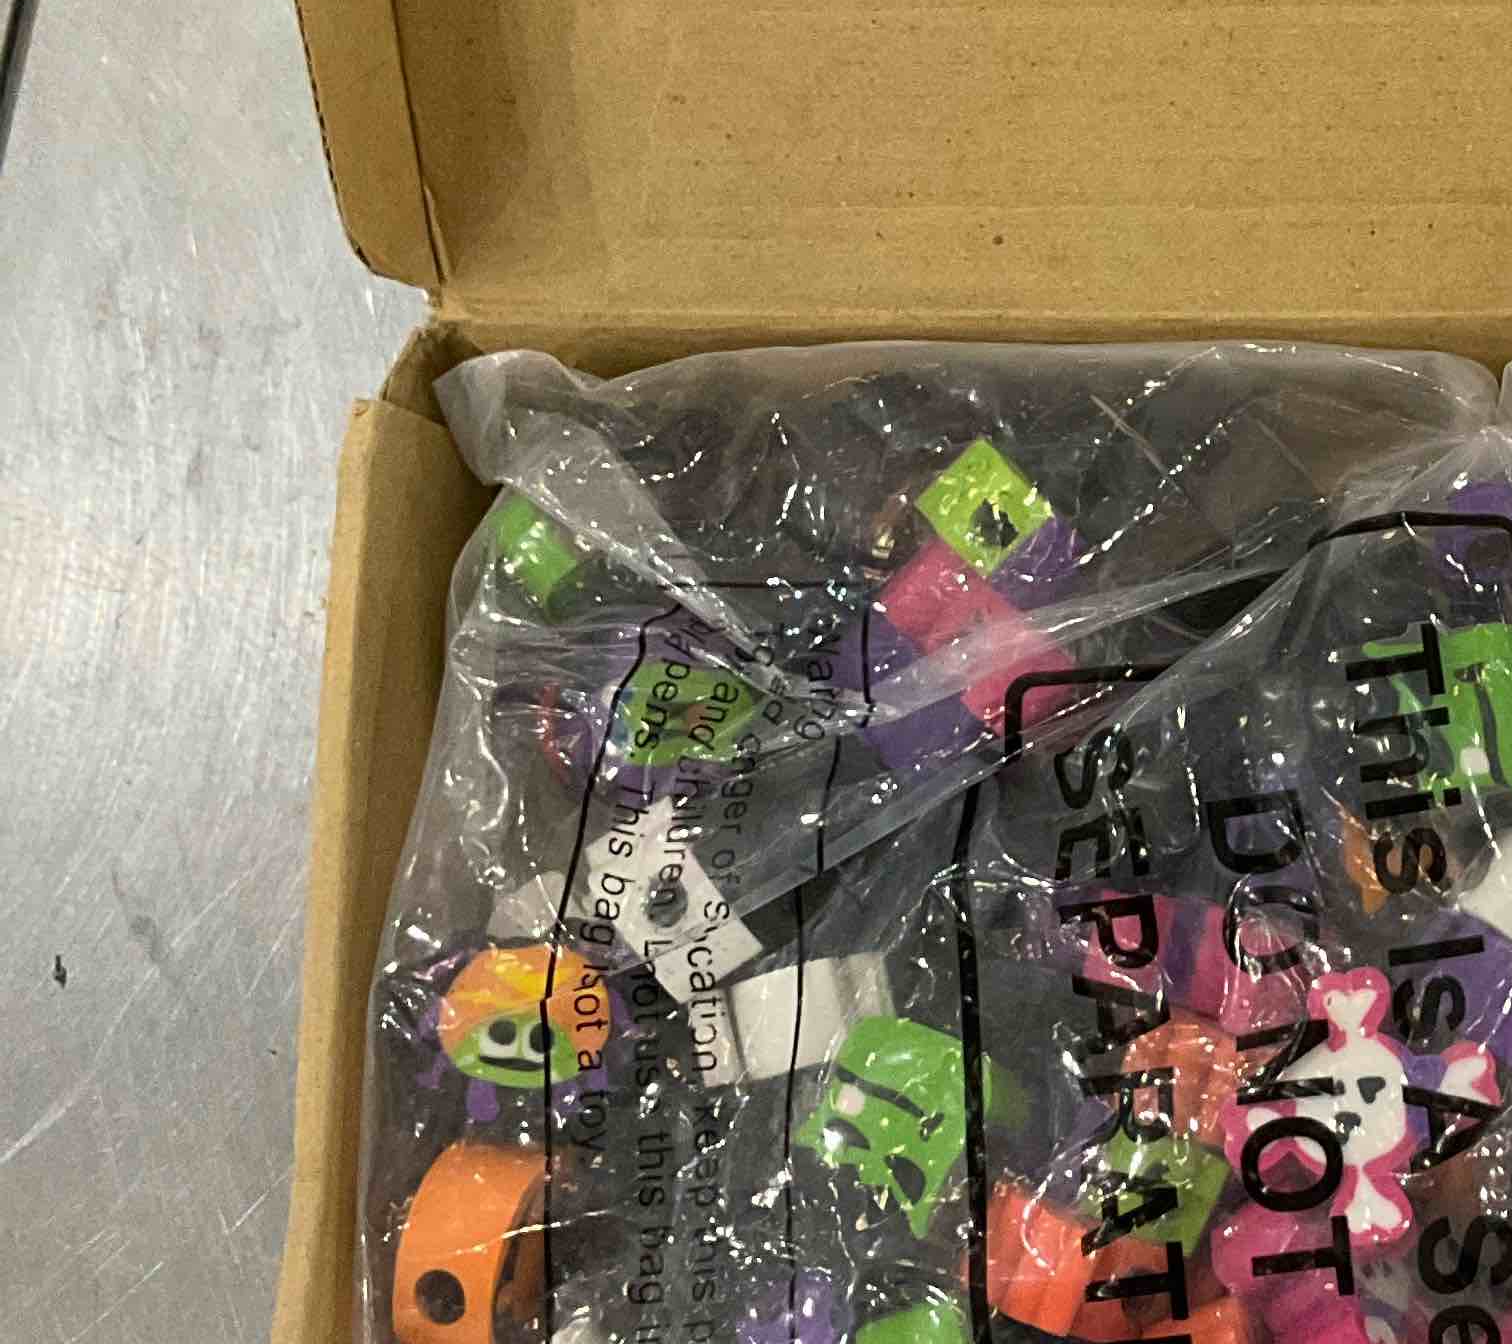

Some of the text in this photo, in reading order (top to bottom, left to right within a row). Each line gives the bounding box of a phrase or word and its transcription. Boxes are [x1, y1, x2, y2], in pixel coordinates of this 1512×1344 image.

[687, 681, 740, 753] and
[1342, 623, 1466, 895] This
[608, 785, 650, 858] This
[711, 849, 744, 886] of
[579, 872, 637, 946] bag
[1385, 934, 1486, 1042] Is
[577, 1049, 601, 1073] a
[1202, 787, 1355, 1299] DO NOT
[1404, 1084, 1508, 1172] A
[637, 1131, 674, 1208] this
[627, 1226, 673, 1305] bag
